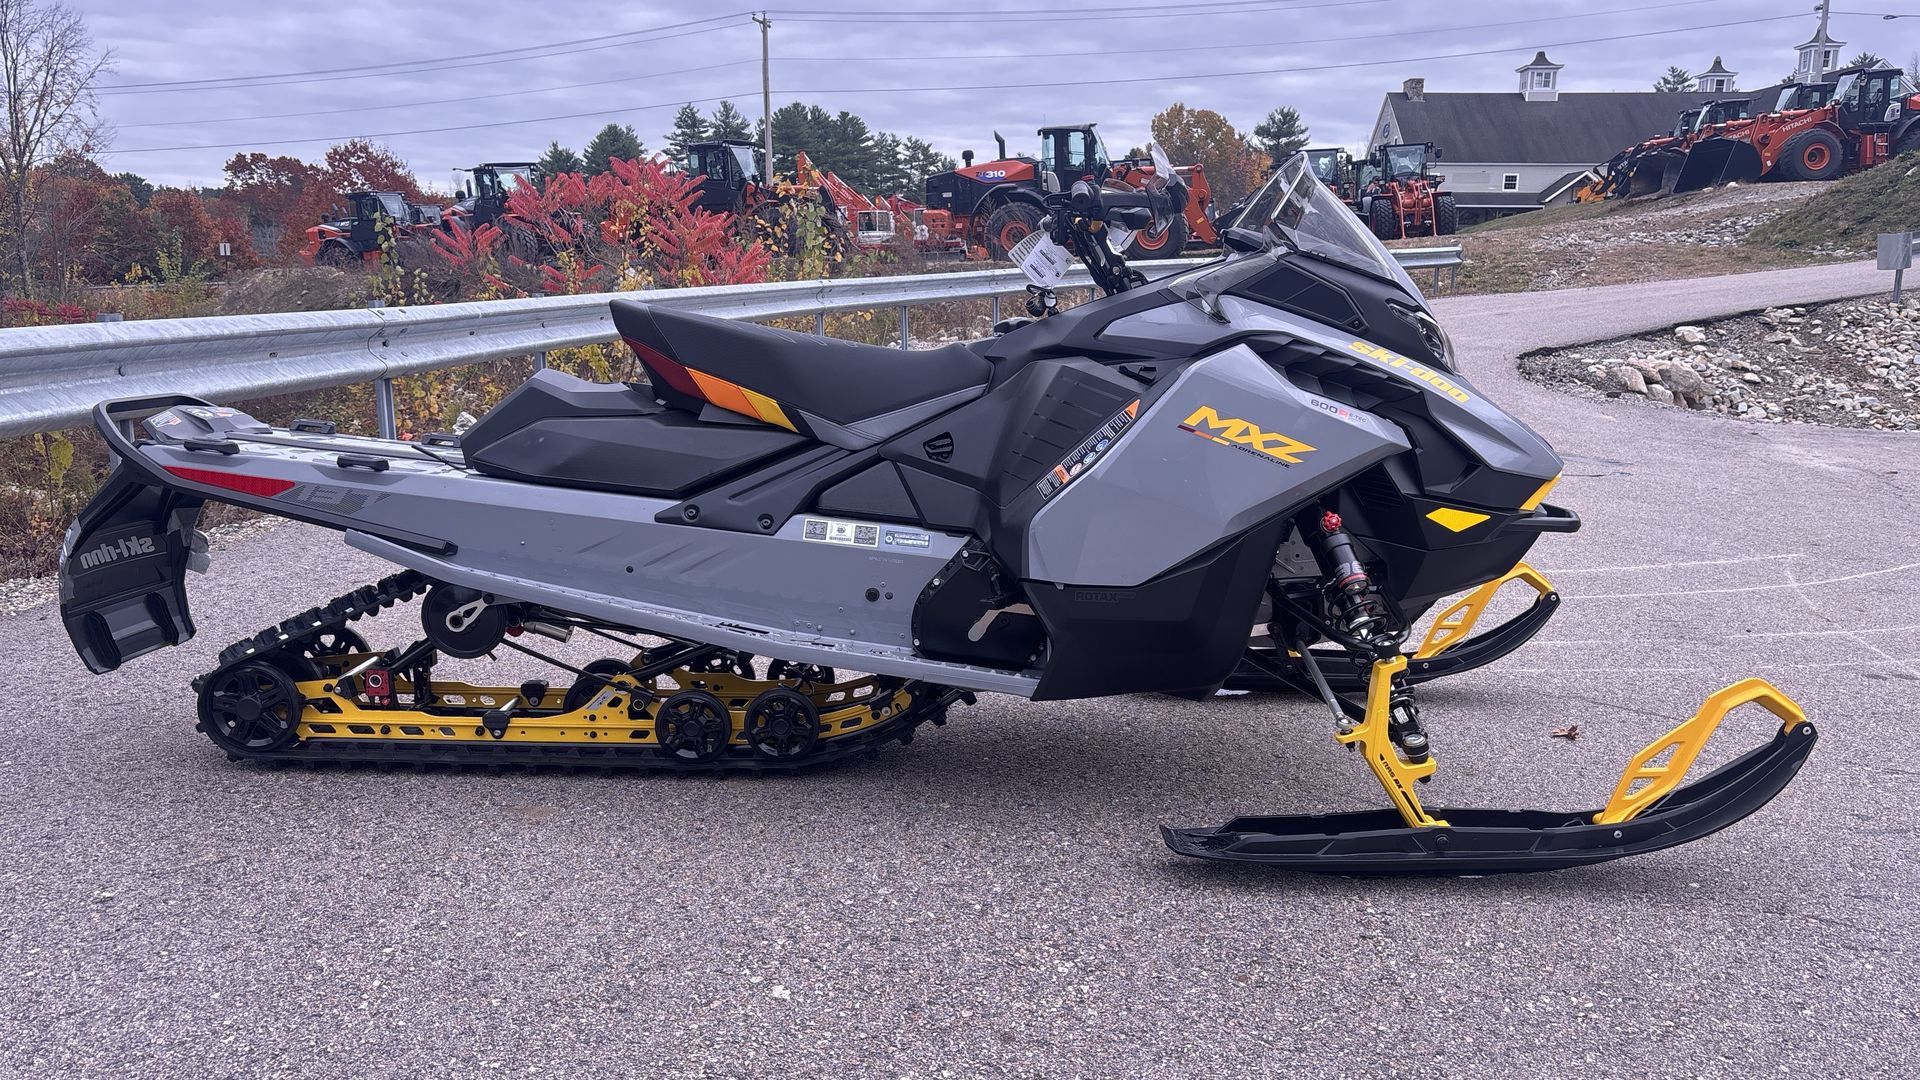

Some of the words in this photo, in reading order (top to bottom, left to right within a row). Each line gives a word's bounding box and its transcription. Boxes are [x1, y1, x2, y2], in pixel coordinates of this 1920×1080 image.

[1782, 116, 1812, 132] HITACHI
[1183, 405, 1319, 464] MXZ
[1230, 443, 1292, 469] ADRENALINE
[1075, 591, 1119, 602] ROTAX
